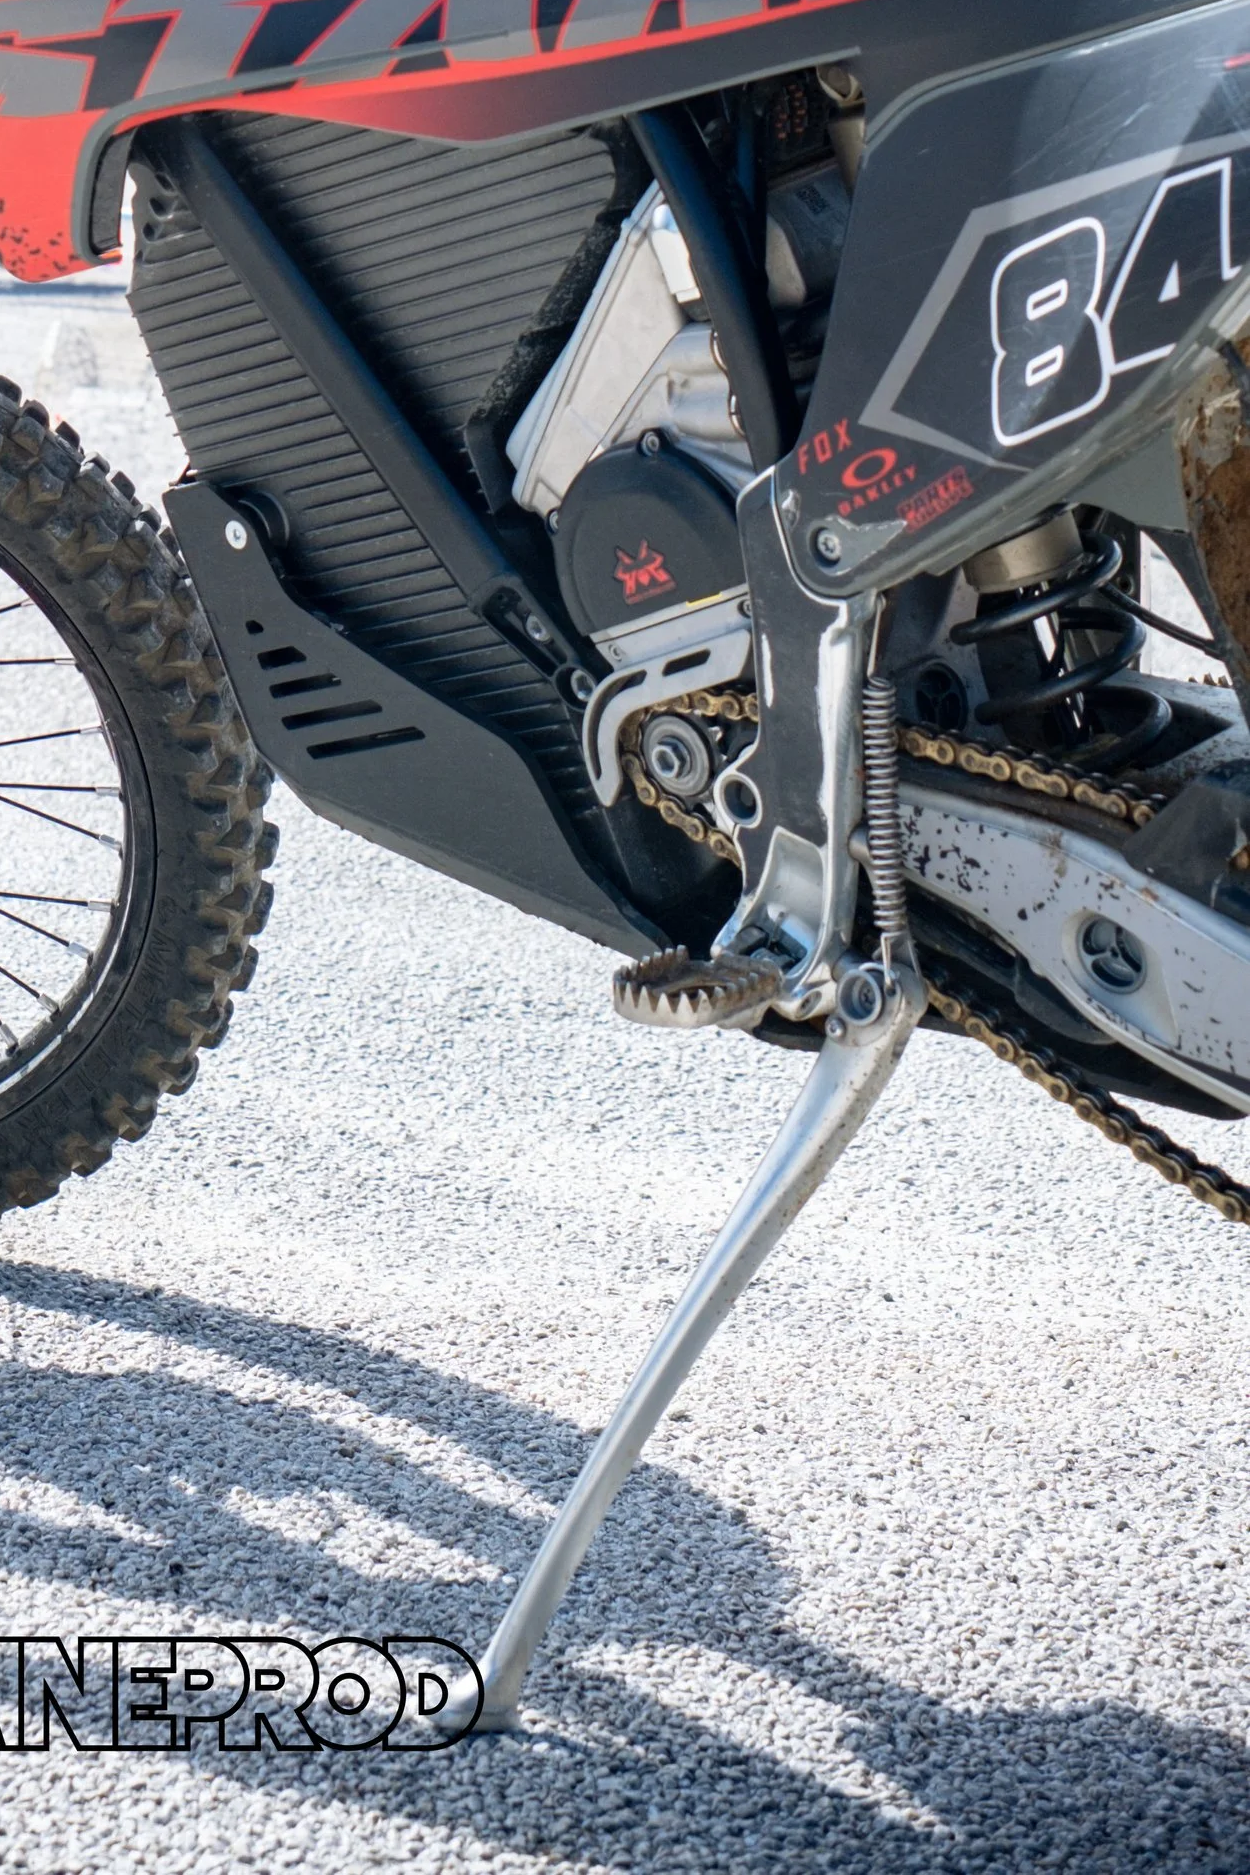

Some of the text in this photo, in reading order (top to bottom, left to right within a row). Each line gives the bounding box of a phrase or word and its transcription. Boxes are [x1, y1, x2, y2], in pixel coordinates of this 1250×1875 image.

[991, 156, 1244, 447] 84
[798, 418, 851, 475] FOX
[837, 465, 917, 518] OAKLEY
